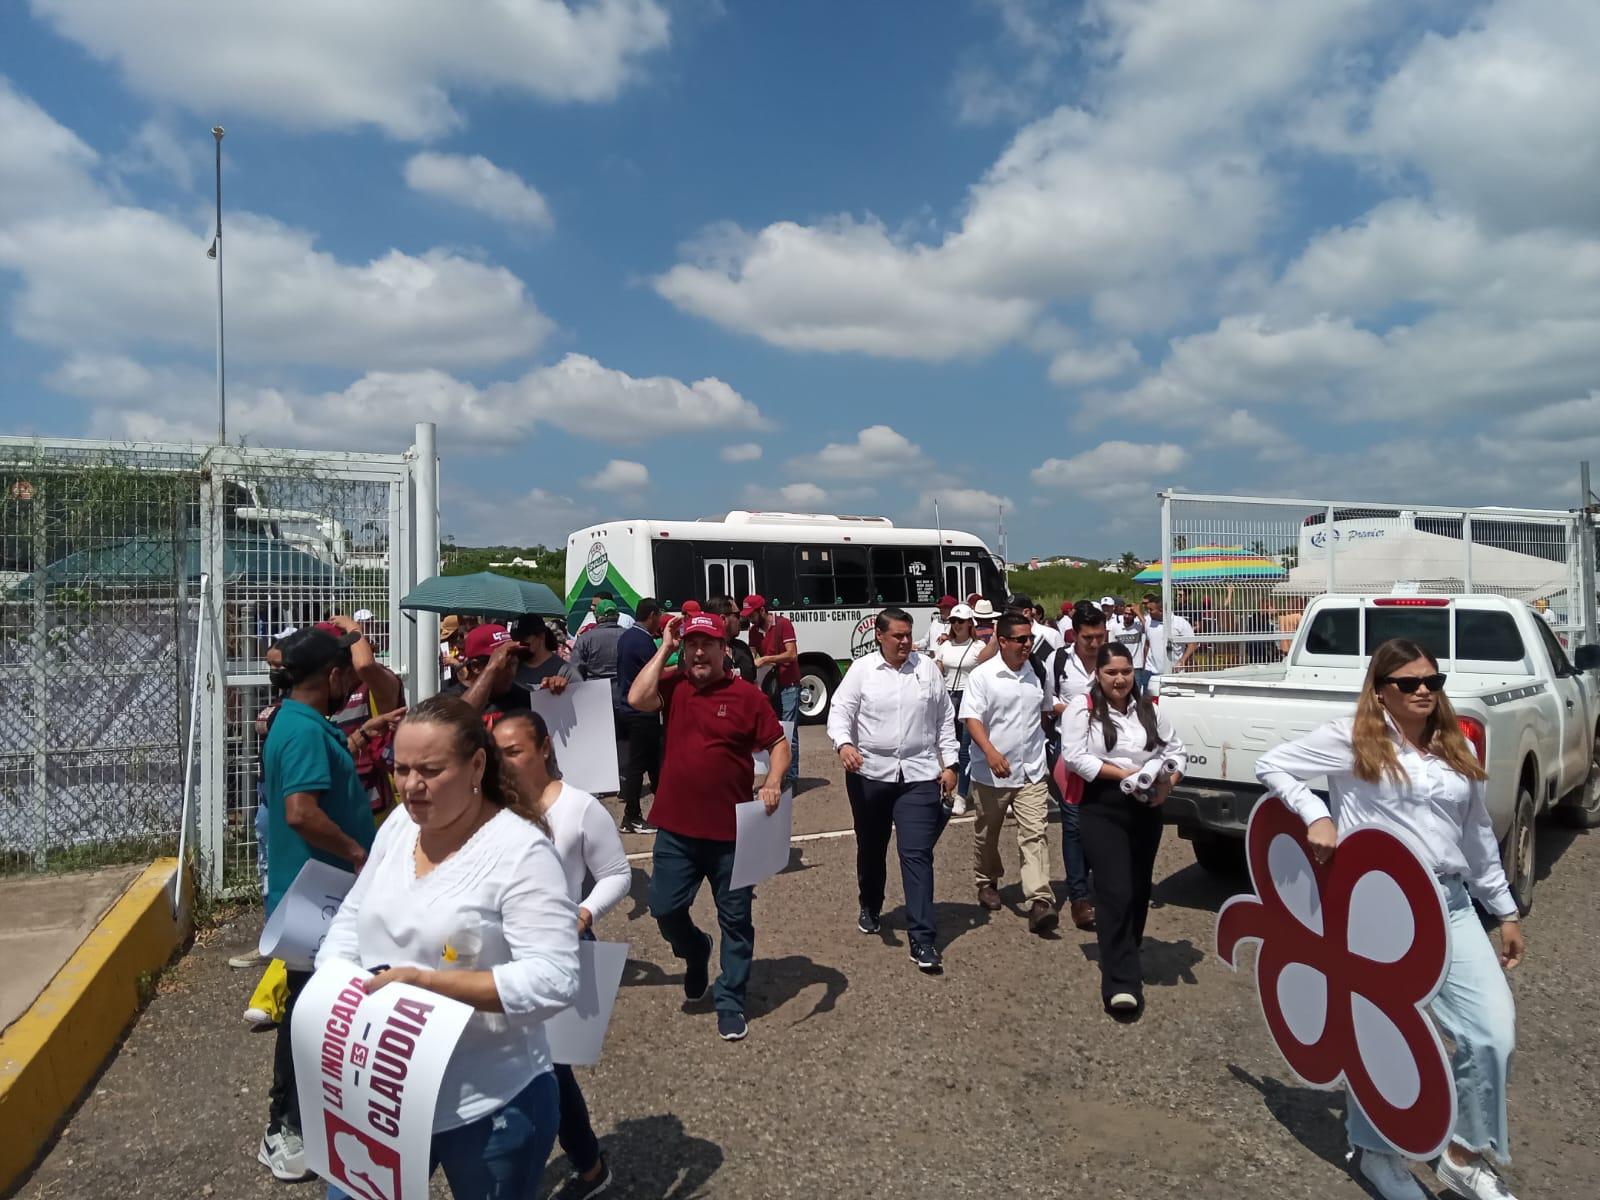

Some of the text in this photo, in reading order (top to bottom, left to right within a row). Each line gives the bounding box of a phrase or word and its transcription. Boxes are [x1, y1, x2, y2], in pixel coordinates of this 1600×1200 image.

[789, 611, 819, 622] BONITO
[831, 610, 861, 621] CENTRO
[857, 617, 877, 634] PUR
[321, 976, 369, 1082] INDICADA
[353, 1046, 367, 1065] ES
[367, 997, 436, 1138] CLAUDIA
[322, 1080, 344, 1110] LA
